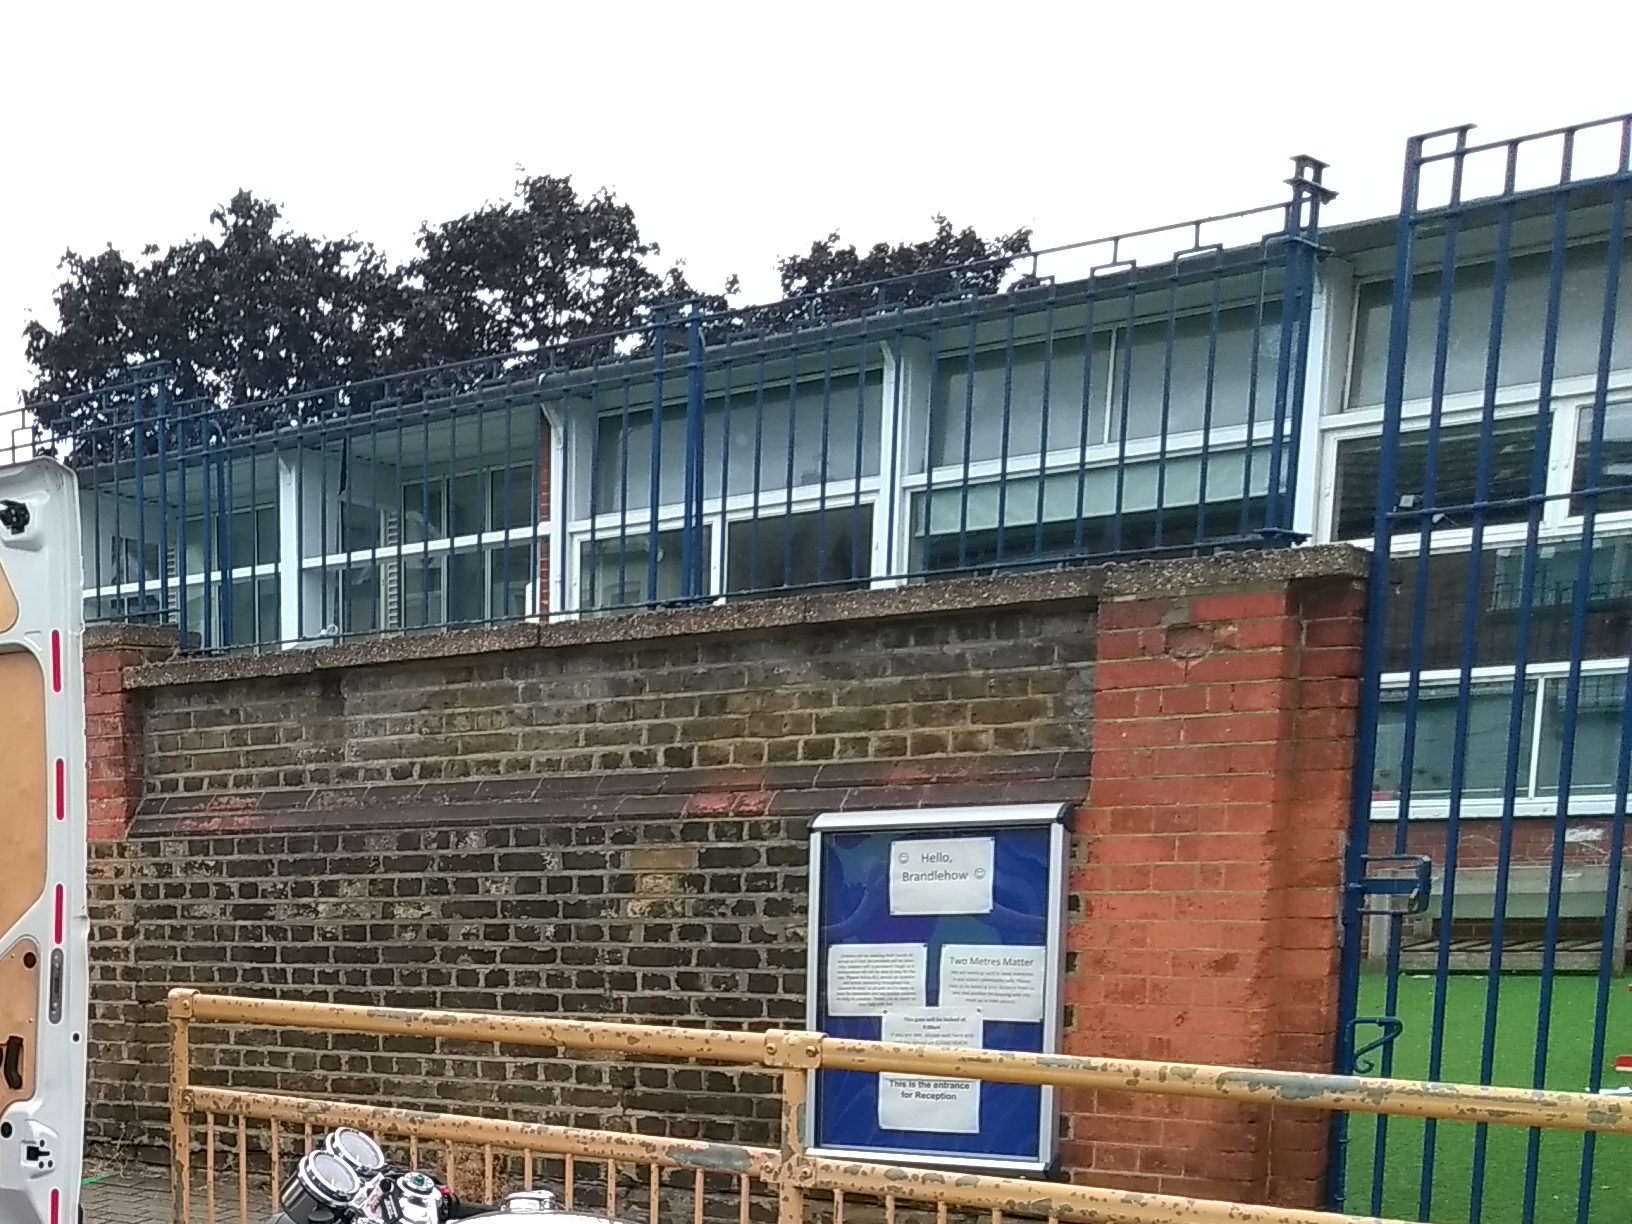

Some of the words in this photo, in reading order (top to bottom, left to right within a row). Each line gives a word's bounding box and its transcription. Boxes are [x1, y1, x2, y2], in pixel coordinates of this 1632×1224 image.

[921, 852, 953, 863] Hello,
[902, 869, 968, 882] Brandlehow
[950, 956, 968, 966] Two
[970, 957, 1001, 966] Metres
[1003, 957, 1034, 967] Matter
[889, 1080, 907, 1088] This
[909, 1080, 916, 1088] is
[918, 1081, 931, 1089] the
[933, 1082, 970, 1090] entrance
[901, 1091, 913, 1099] for
[915, 1091, 957, 1101] Reception
